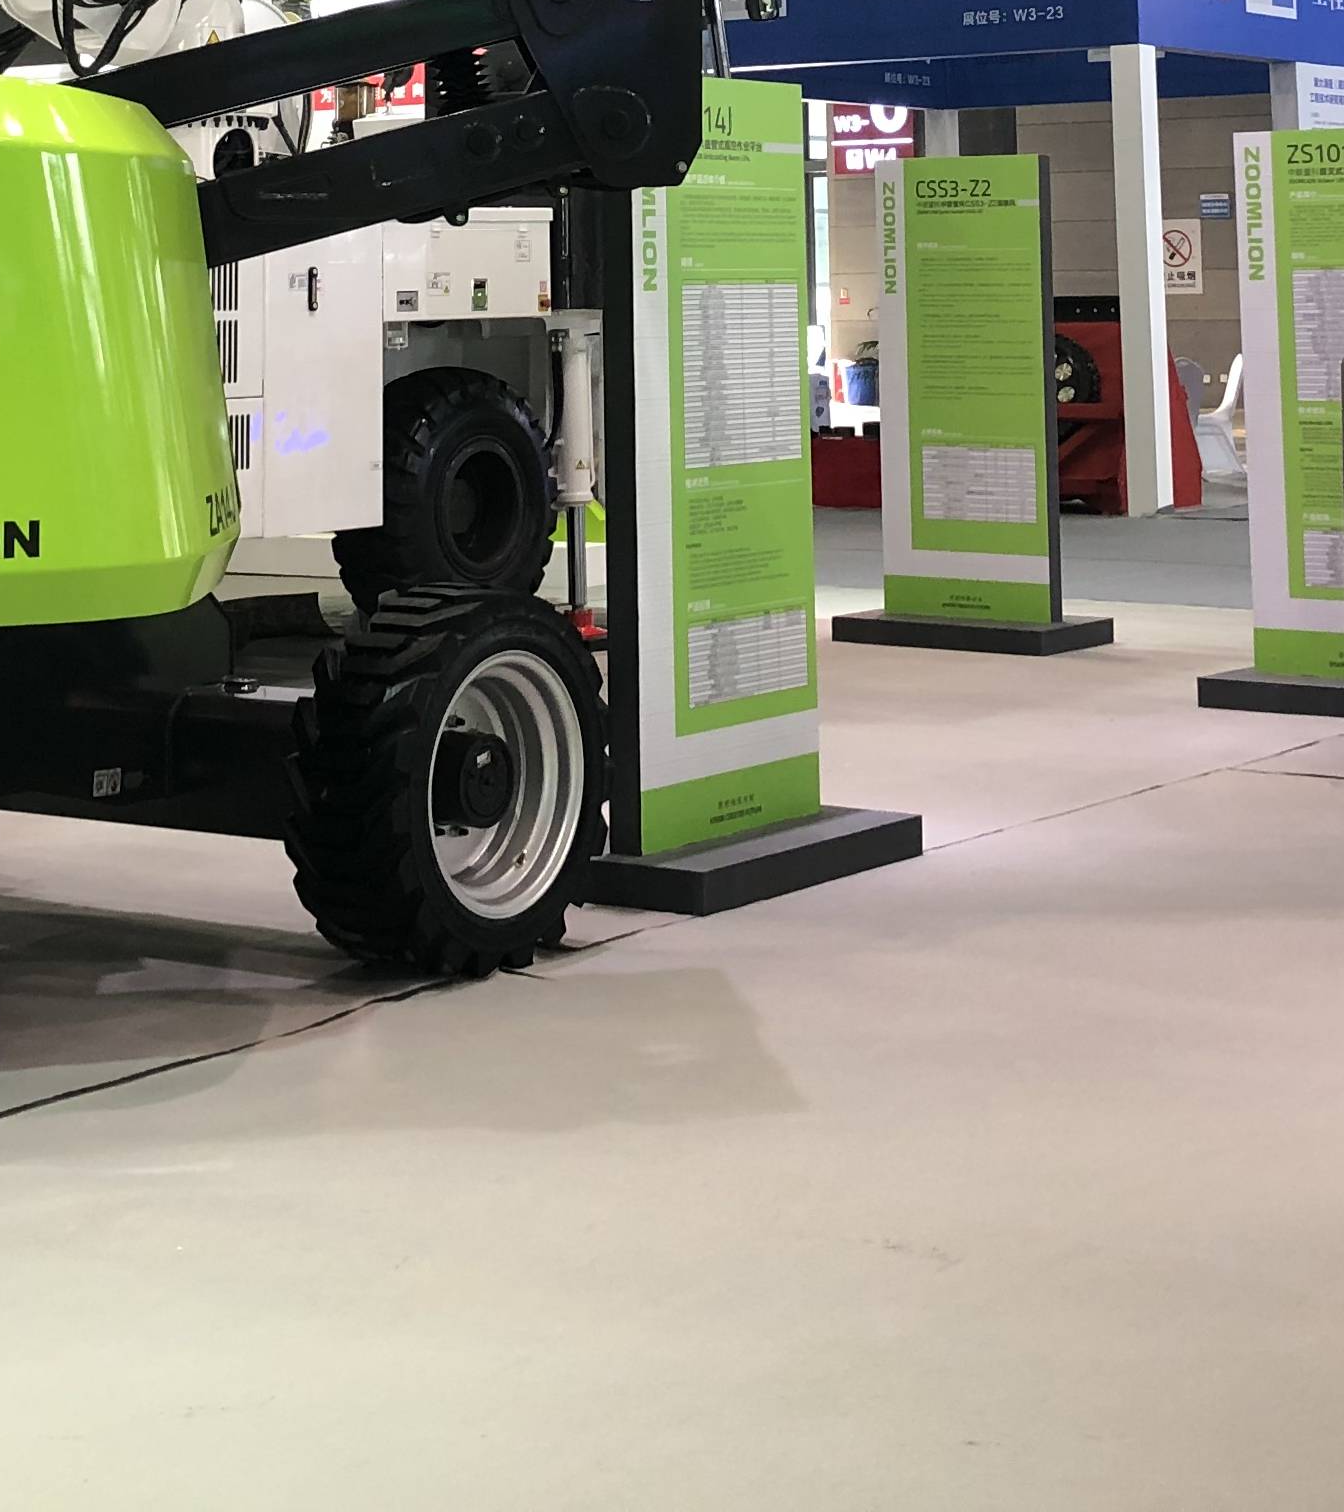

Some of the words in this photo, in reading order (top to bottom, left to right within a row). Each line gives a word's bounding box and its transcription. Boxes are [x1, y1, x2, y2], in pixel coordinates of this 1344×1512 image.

[882, 181, 897, 295] ZOOMLION
[916, 179, 992, 198] CSS3-Z2
[1243, 146, 1265, 281] ZOOMLION
